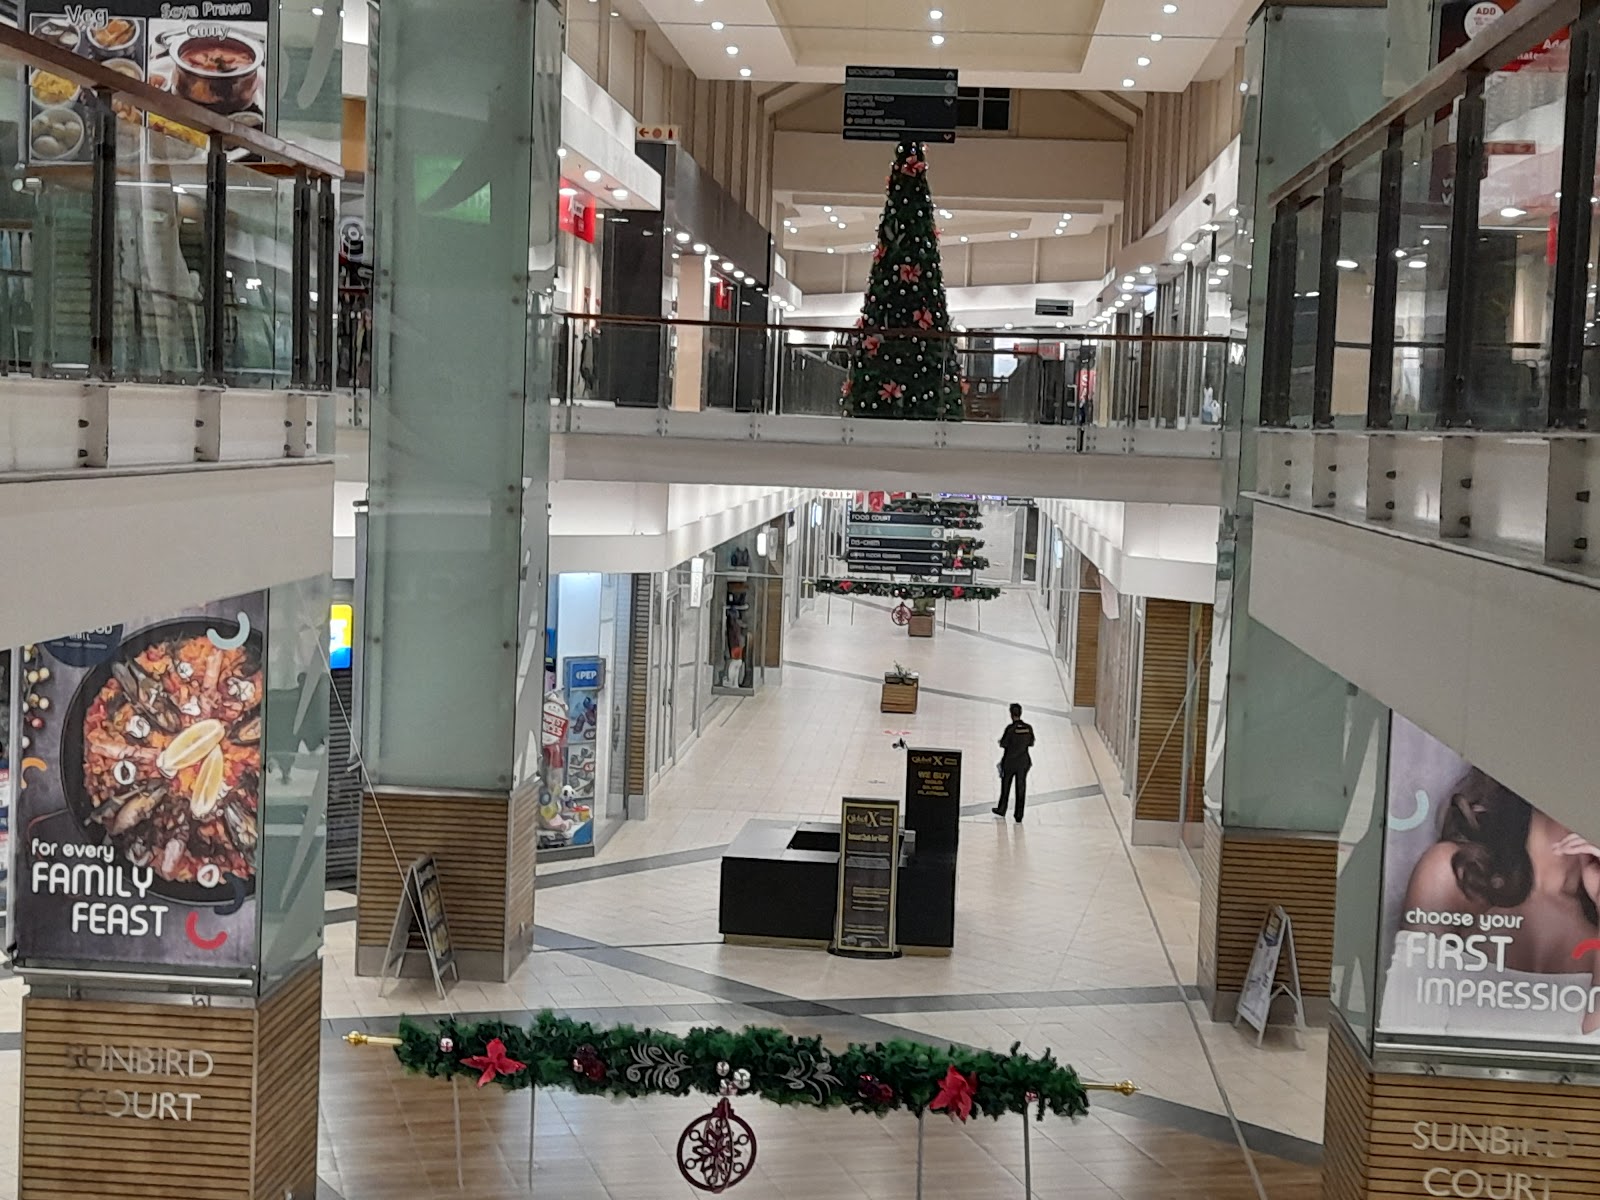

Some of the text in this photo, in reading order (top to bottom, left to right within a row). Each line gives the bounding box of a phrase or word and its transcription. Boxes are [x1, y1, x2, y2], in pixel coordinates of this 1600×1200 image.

[65, 5, 108, 28] Veg
[202, 1, 252, 17] Prawn
[1475, 7, 1496, 16] ADD
[186, 24, 230, 40] Curry
[580, 670, 597, 680] PEP
[31, 838, 114, 863] for every
[31, 861, 153, 898] FAMILY
[71, 902, 169, 937] FEAST
[1405, 907, 1524, 932] choose your
[1405, 931, 1514, 973] FIRST
[65, 1044, 214, 1079] UNBIRD
